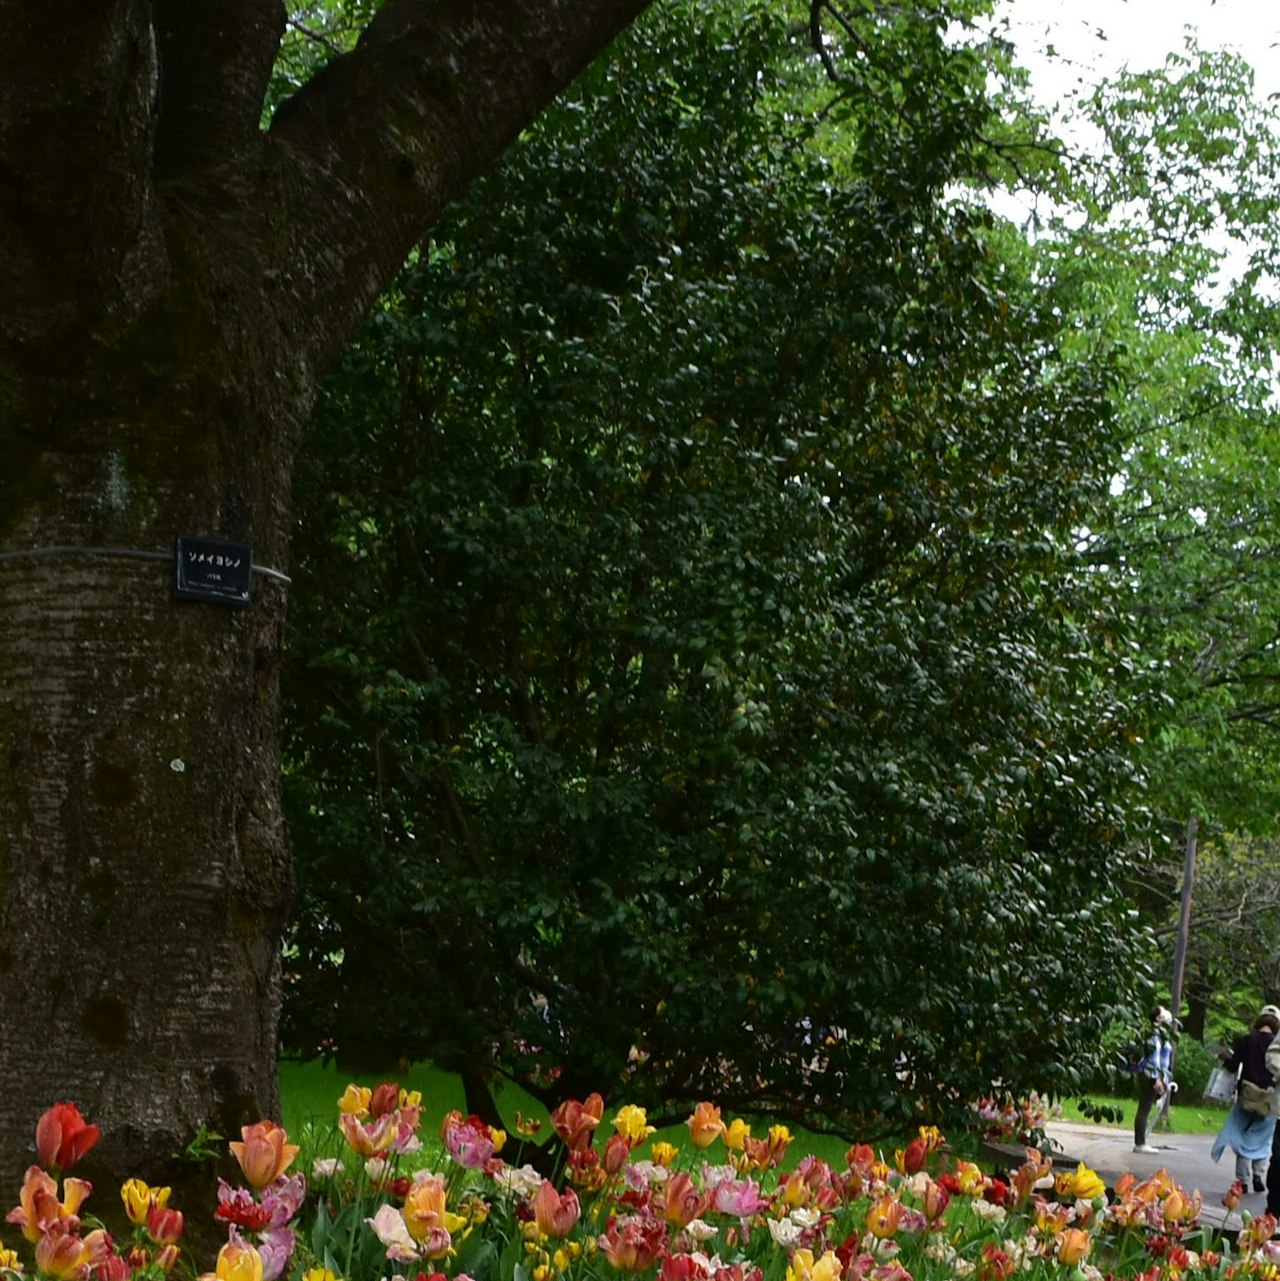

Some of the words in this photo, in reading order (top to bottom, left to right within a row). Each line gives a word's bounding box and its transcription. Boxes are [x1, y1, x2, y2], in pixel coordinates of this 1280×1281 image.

[188, 551, 241, 568] ソメイヨシノ
